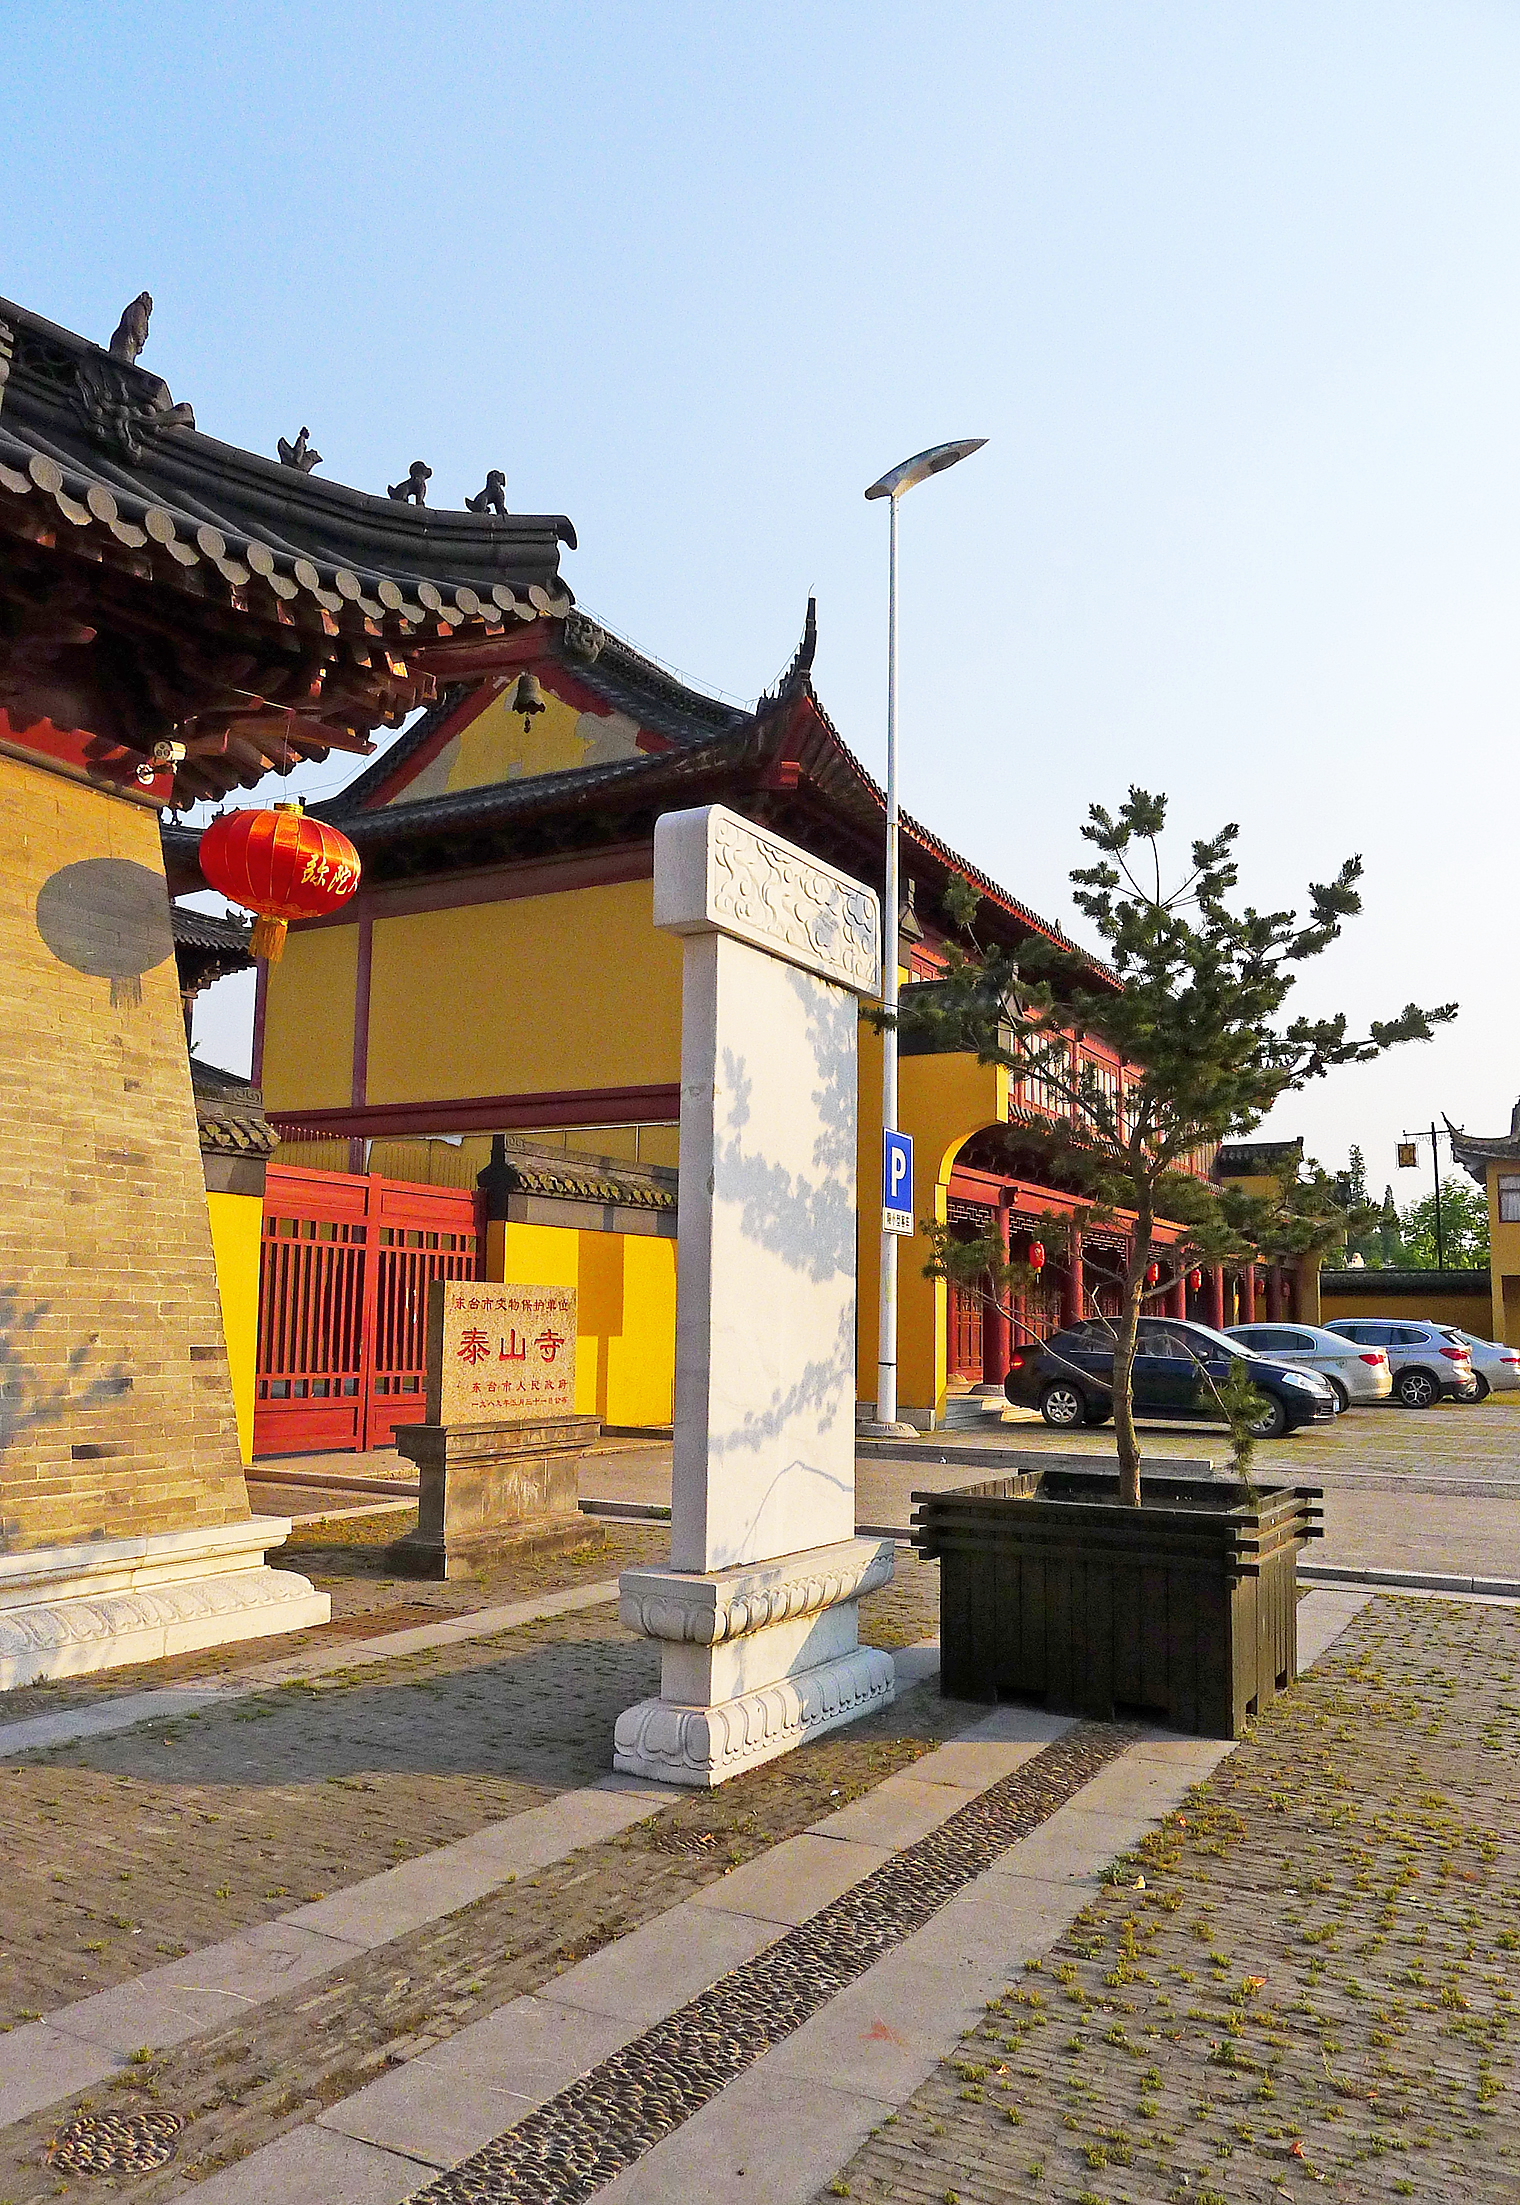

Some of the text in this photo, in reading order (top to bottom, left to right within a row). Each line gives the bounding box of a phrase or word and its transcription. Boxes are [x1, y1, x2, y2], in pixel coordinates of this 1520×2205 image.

[891, 1146, 907, 1197] P
[455, 1296, 569, 1311] 东台市文物保护单位
[457, 1327, 565, 1365] 泰山寺
[471, 1380, 568, 1392] 东台市人民政府
